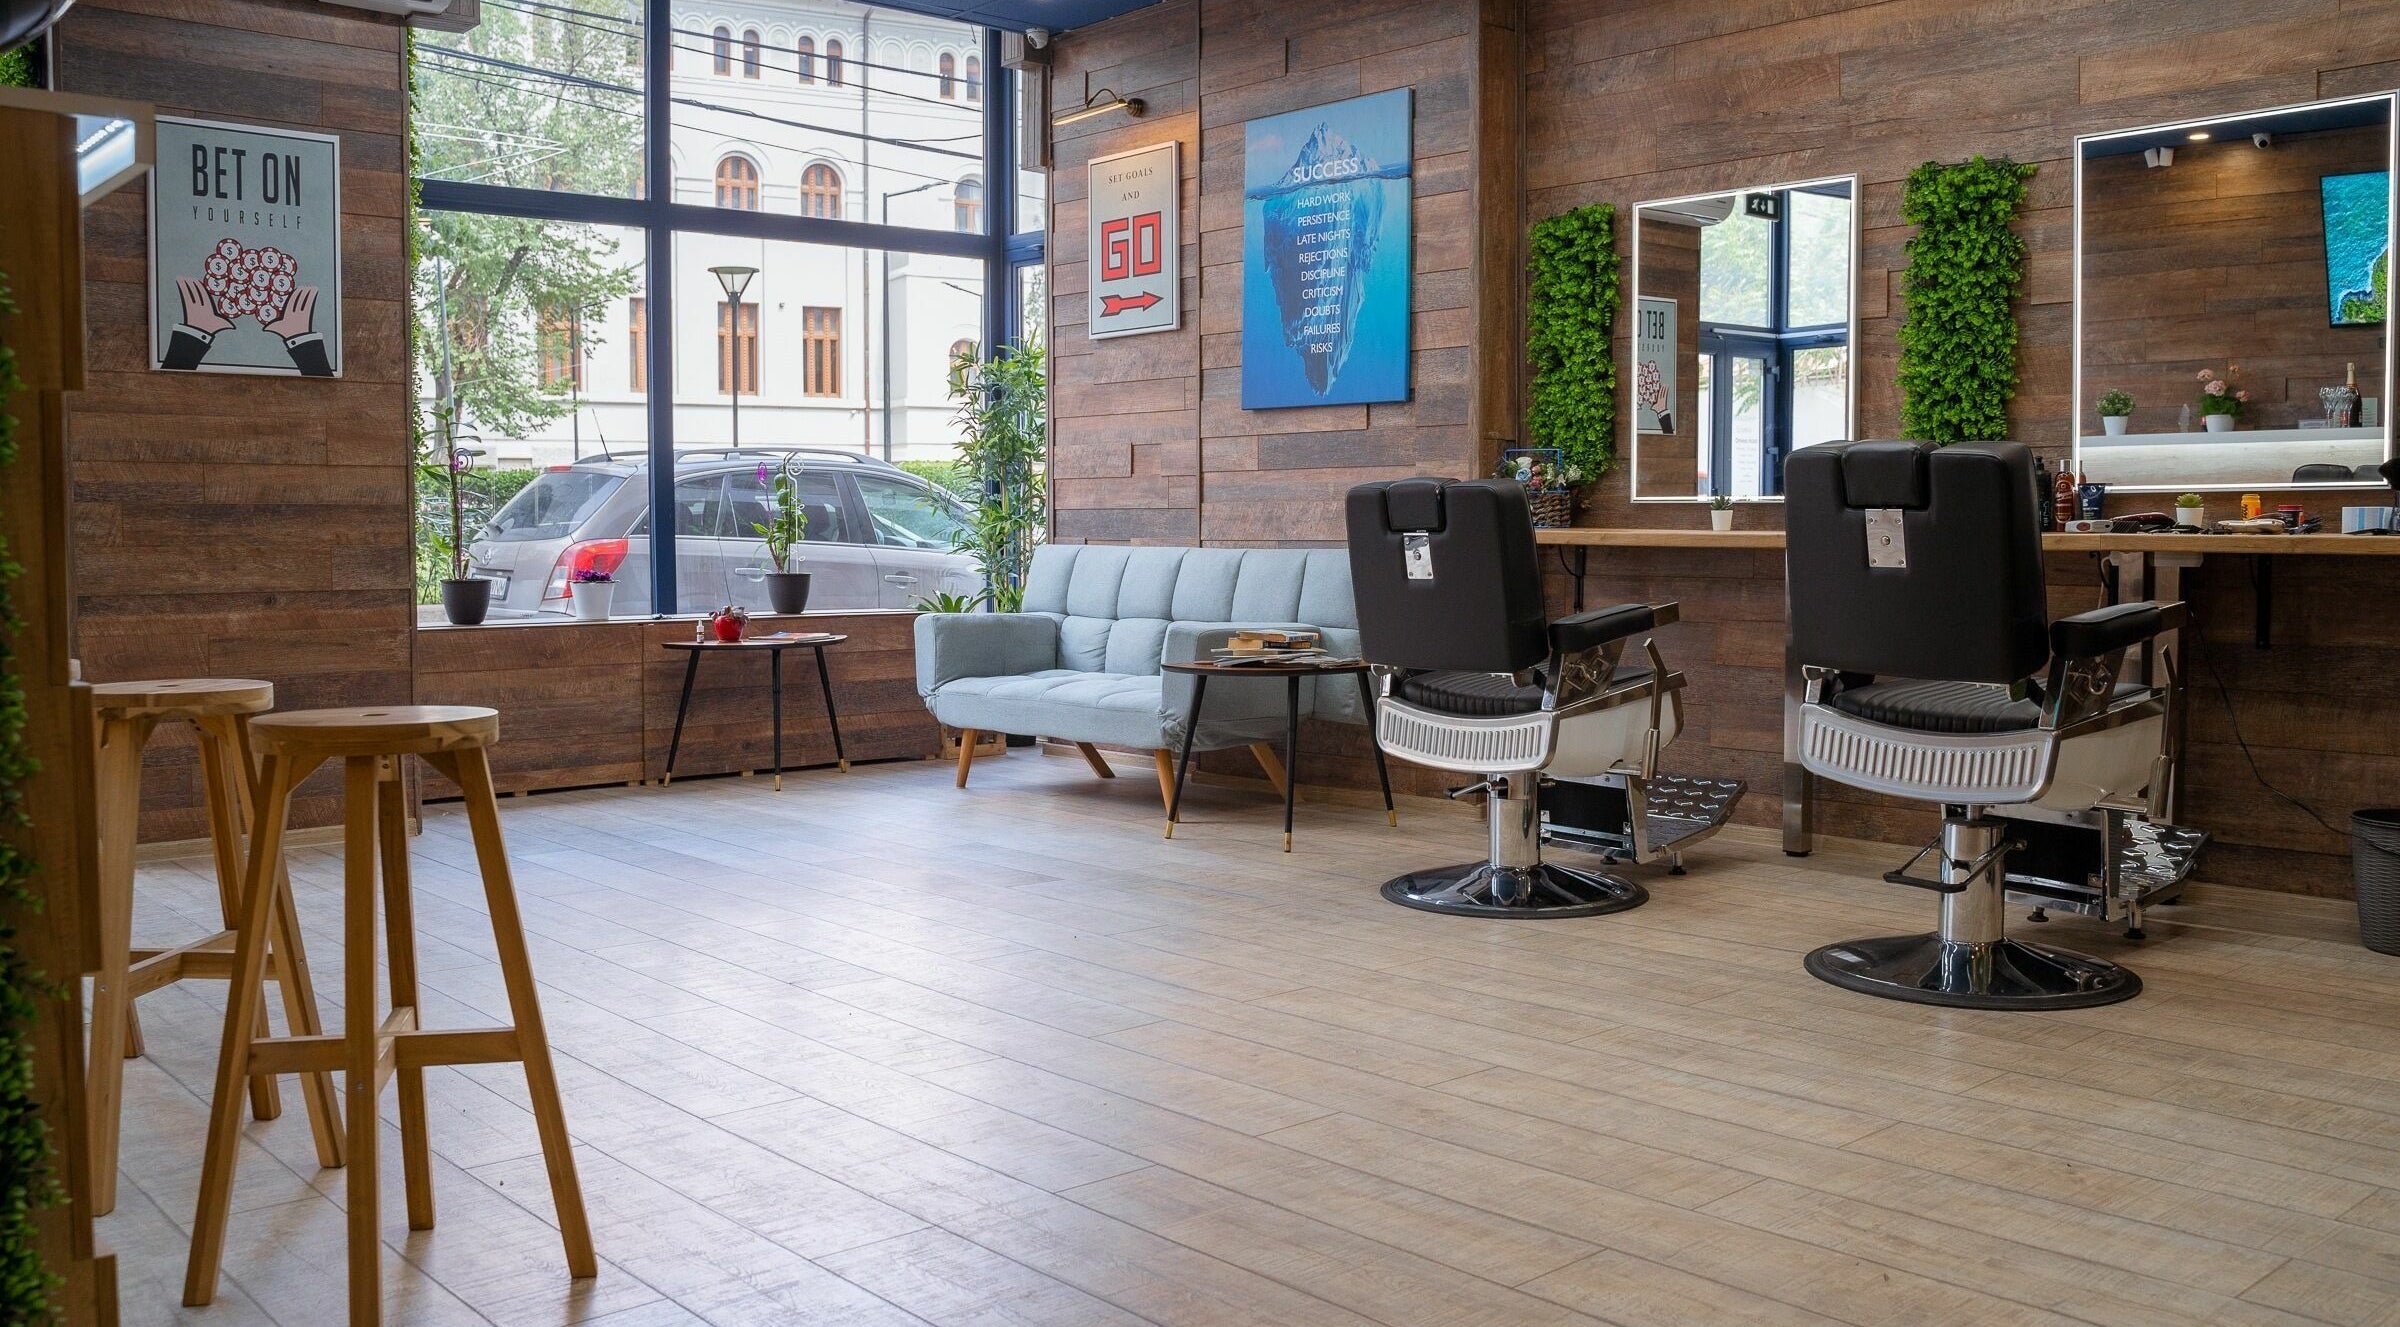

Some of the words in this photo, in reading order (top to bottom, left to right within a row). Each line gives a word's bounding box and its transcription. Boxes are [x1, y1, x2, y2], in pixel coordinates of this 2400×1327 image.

[192, 143, 246, 200] BET
[262, 152, 301, 207] ON
[1108, 173, 1122, 184] SET
[1125, 166, 1153, 180] GOALS
[1293, 157, 1358, 183] SUCCESS
[1121, 190, 1140, 201] AND
[1297, 195, 1322, 208] HARD
[1322, 191, 1351, 205] WORK
[192, 205, 302, 230] YOURSELF
[1297, 209, 1351, 227] PERSISTENCE
[1101, 210, 1161, 282] GO
[1296, 233, 1317, 246] LATE
[1318, 228, 1351, 242] NIGHTS
[1298, 247, 1348, 265] REJECTIONS
[1301, 266, 1345, 281] DISCIPLINE
[1302, 285, 1344, 300] CRITICISM
[1304, 304, 1340, 318] DOUBTS
[1303, 322, 1341, 336] FAILURES
[1310, 342, 1333, 354] RISKS
